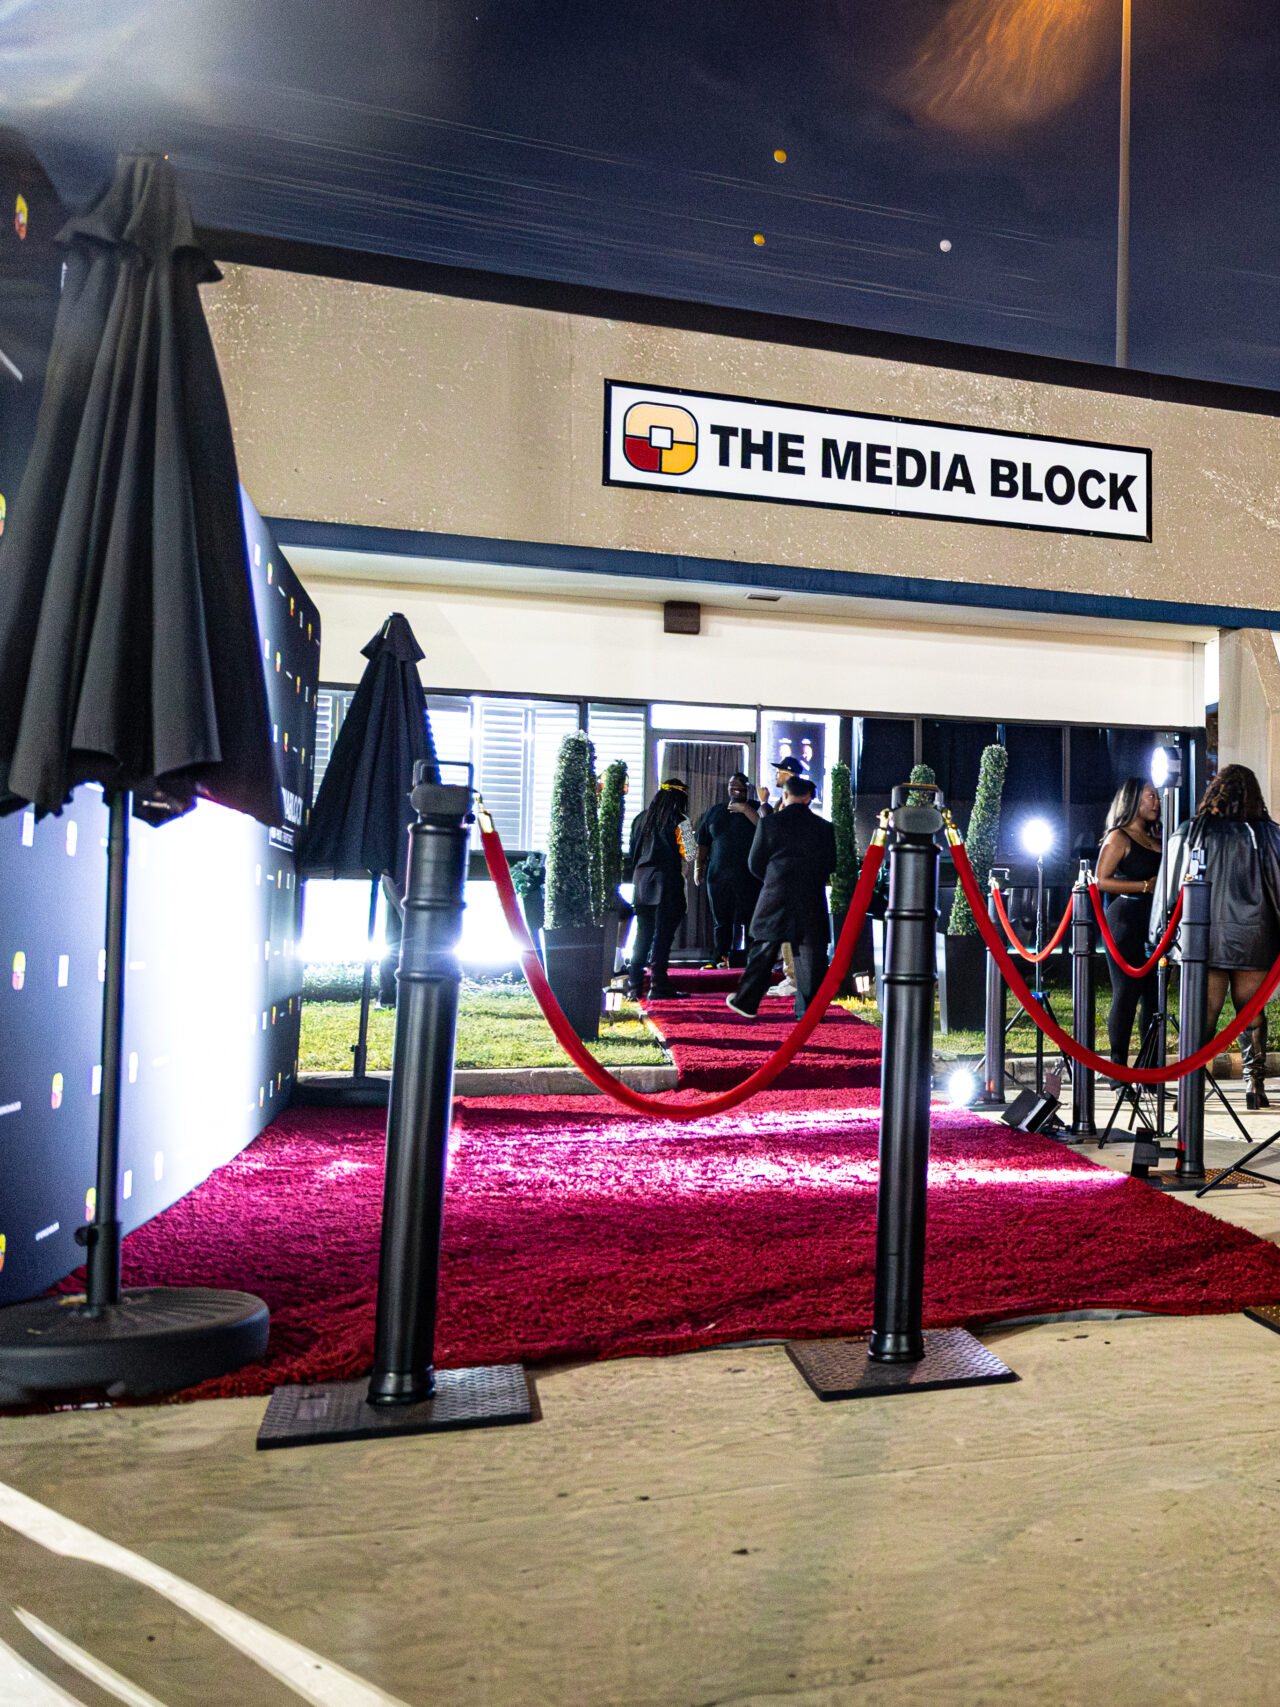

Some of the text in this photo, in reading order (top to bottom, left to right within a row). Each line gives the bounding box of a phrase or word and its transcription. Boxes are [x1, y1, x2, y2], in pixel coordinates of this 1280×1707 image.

[710, 424, 1139, 513] THE MEDIA BLOCK
